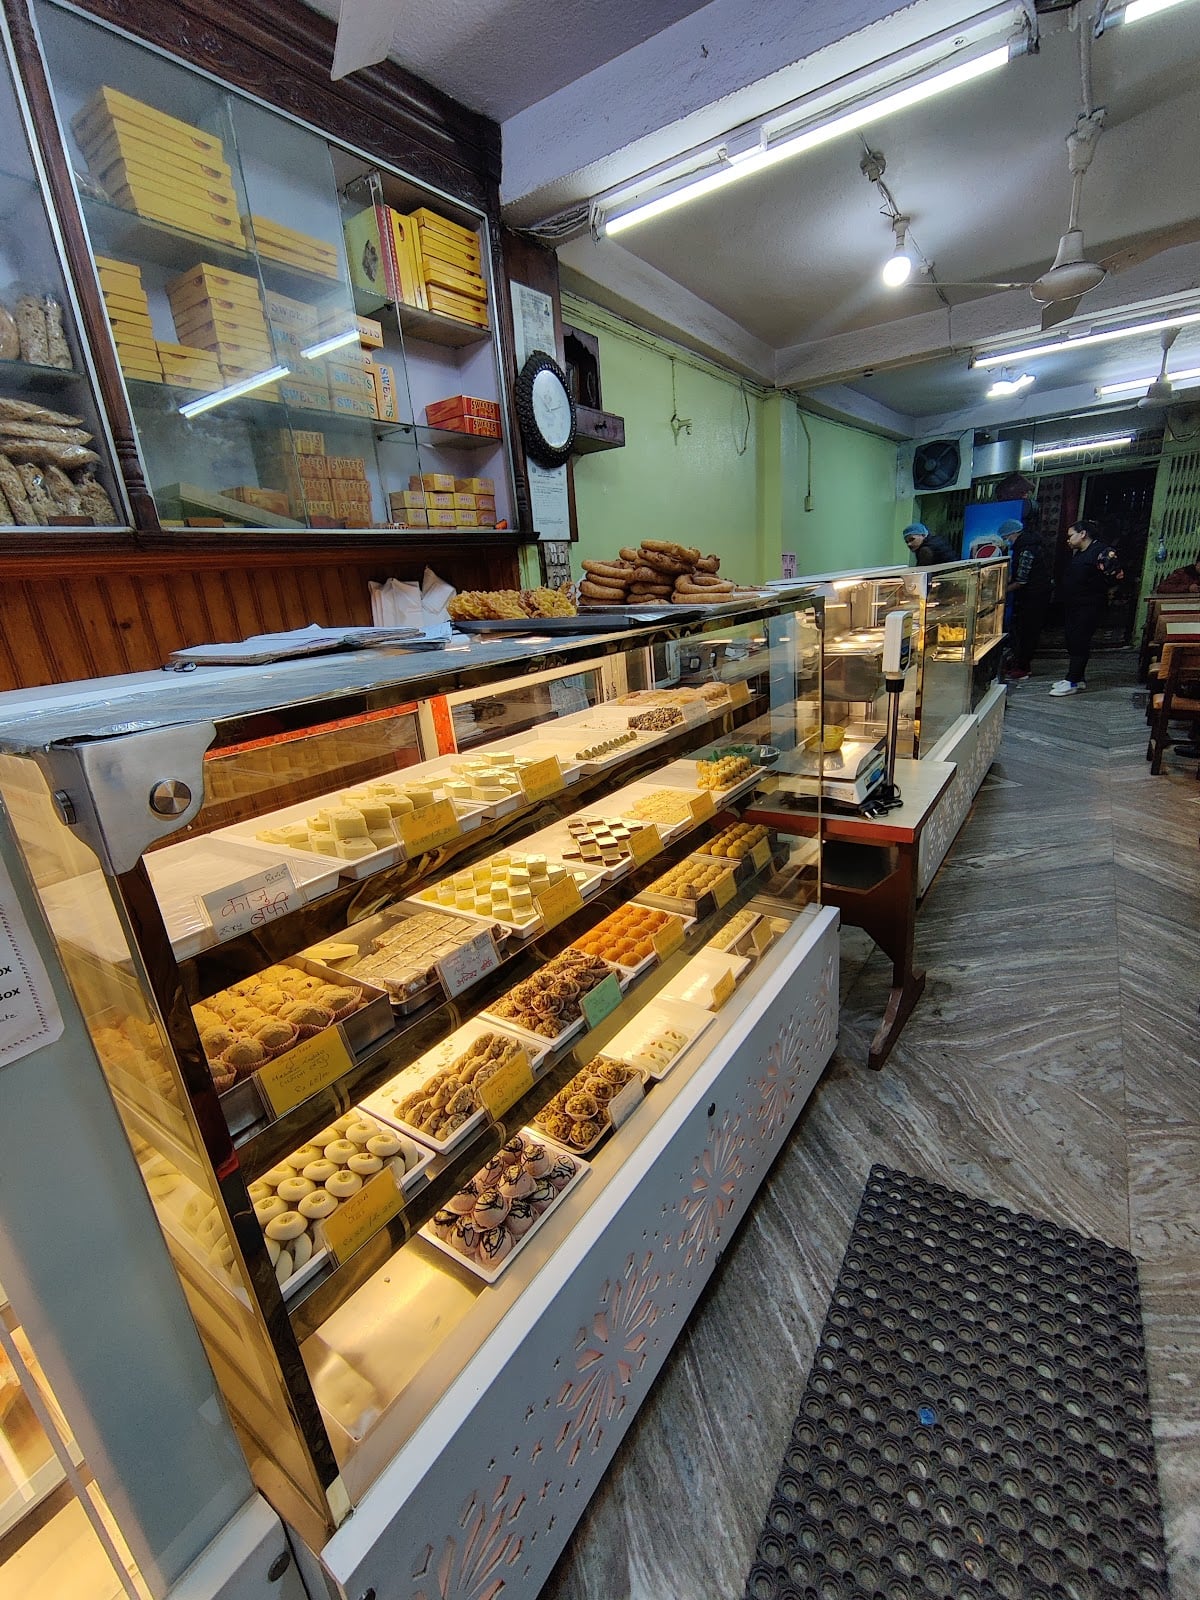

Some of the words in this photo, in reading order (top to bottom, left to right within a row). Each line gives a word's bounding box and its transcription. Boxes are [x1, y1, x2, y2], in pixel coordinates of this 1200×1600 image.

[471, 400, 495, 414] SWEETS
[473, 420, 496, 432] SWEETS
[332, 459, 363, 473] SWEETS
